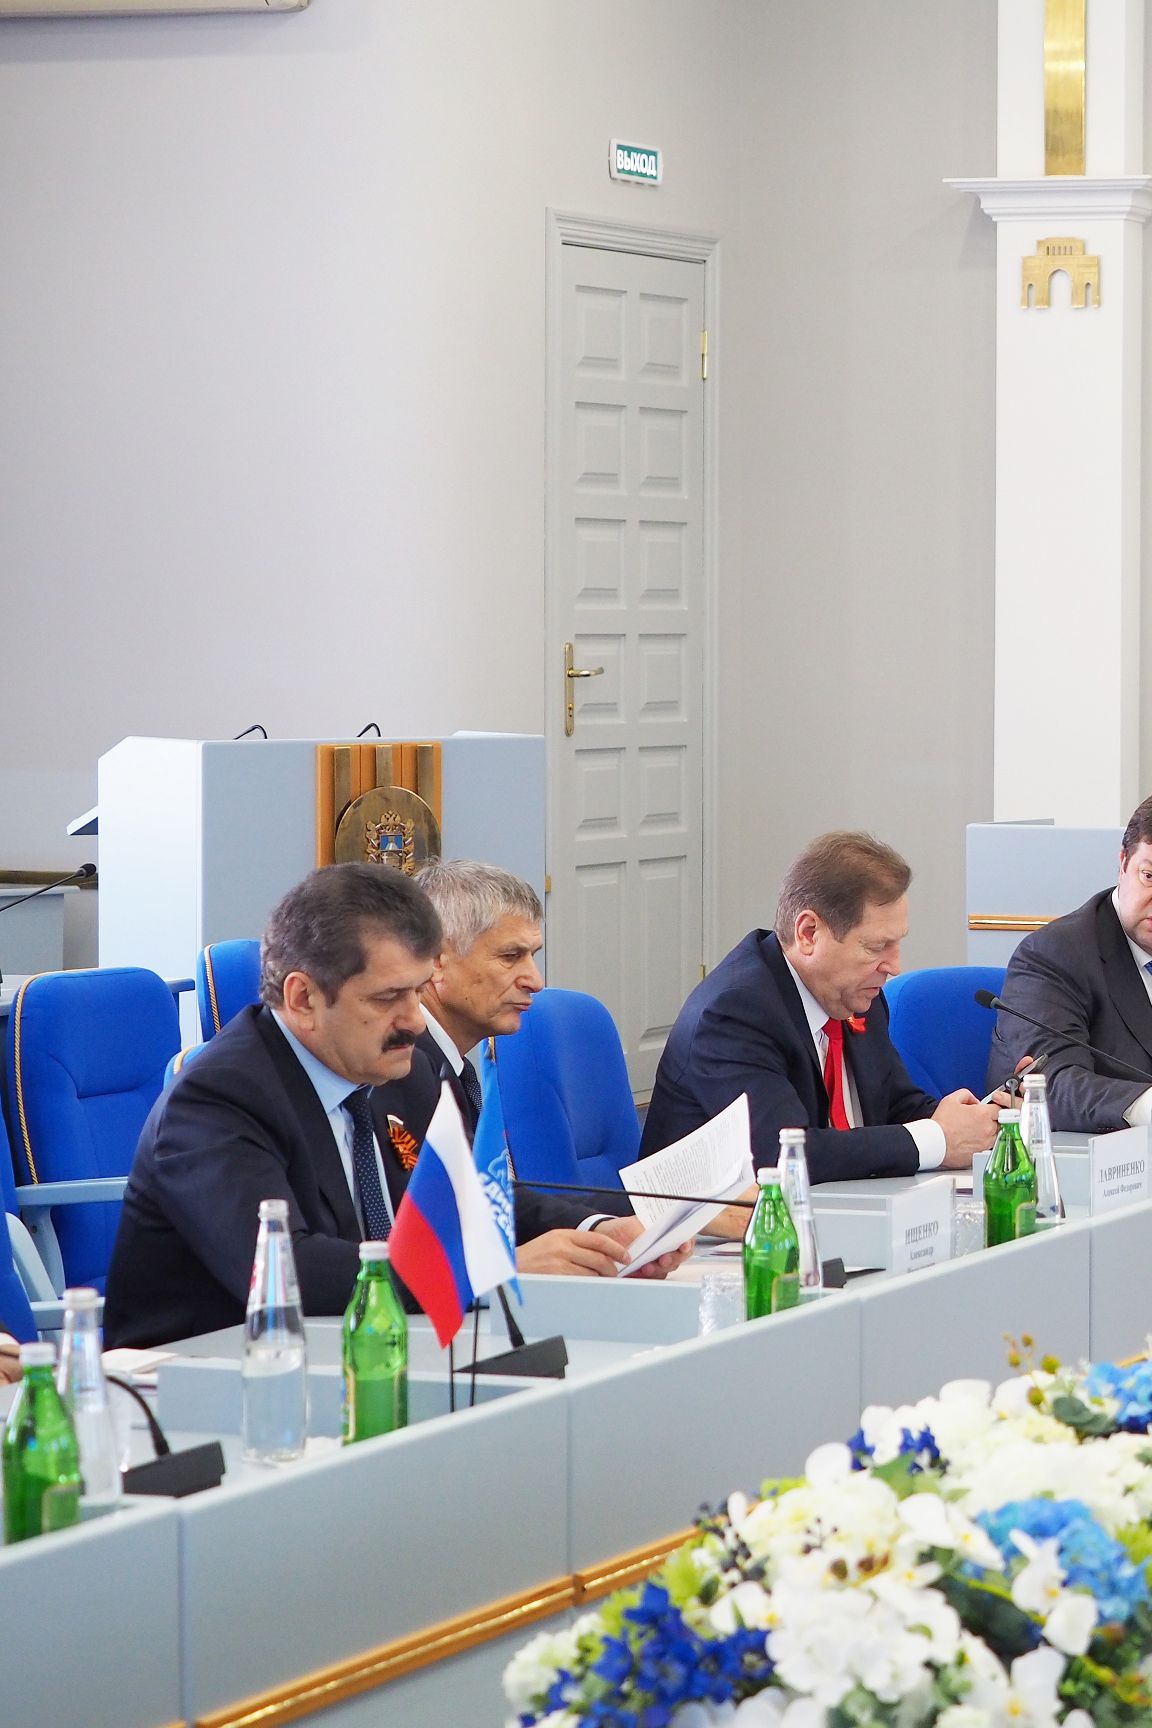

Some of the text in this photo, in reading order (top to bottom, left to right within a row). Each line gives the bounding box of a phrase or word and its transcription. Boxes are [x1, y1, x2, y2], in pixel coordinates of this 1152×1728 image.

[616, 149, 657, 177] ВЫХОД
[1098, 1159, 1145, 1183] ЛАВРИНЕНКО
[905, 1220, 939, 1245] ИЩЕНКО
